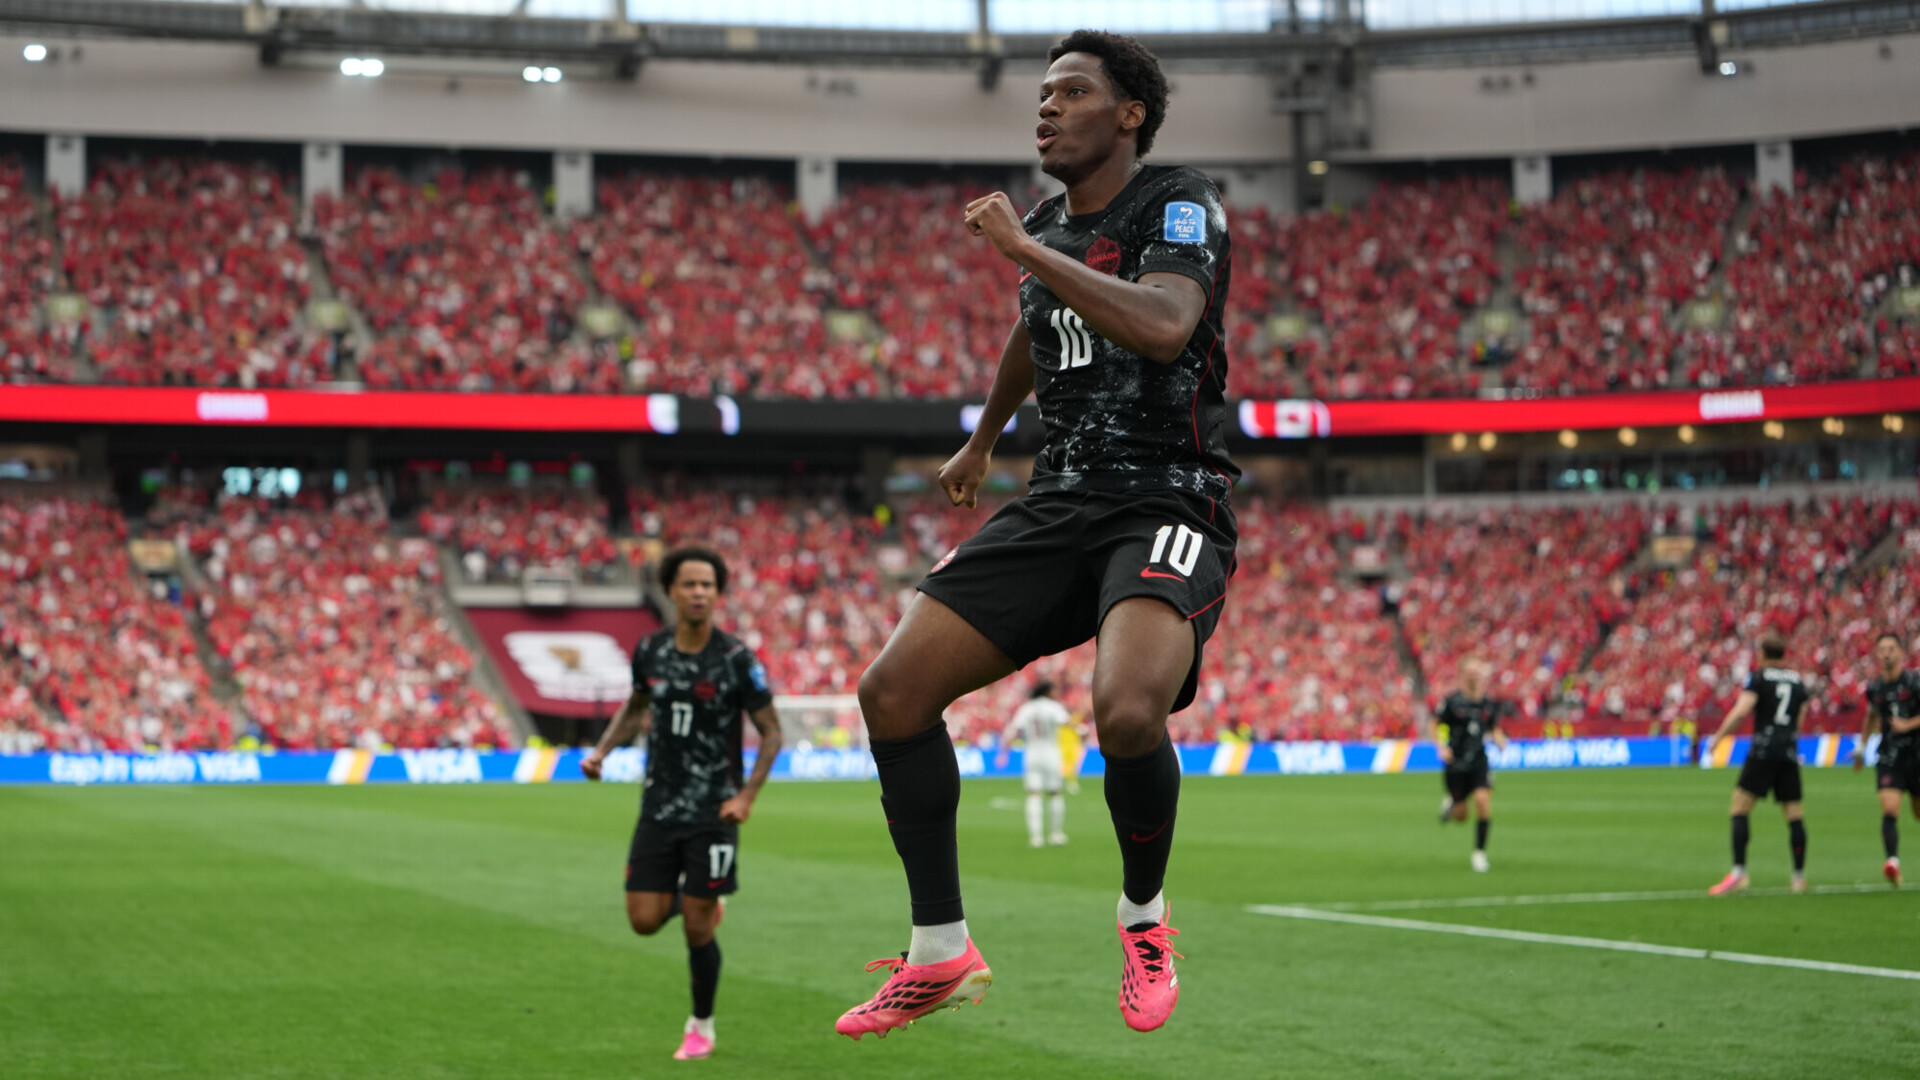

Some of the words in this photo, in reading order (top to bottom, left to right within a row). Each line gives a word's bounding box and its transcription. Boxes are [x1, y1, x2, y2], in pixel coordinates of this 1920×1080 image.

[1174, 224, 1195, 233] PEACE
[1087, 251, 1119, 265] CANADA
[1050, 307, 1093, 371] 10
[1149, 523, 1203, 577] 10
[670, 700, 694, 738] 17
[198, 752, 262, 782] VISA
[401, 748, 483, 782] VISA
[1274, 740, 1346, 773] VISA
[1577, 738, 1631, 766] VISA
[708, 843, 735, 879] 17
